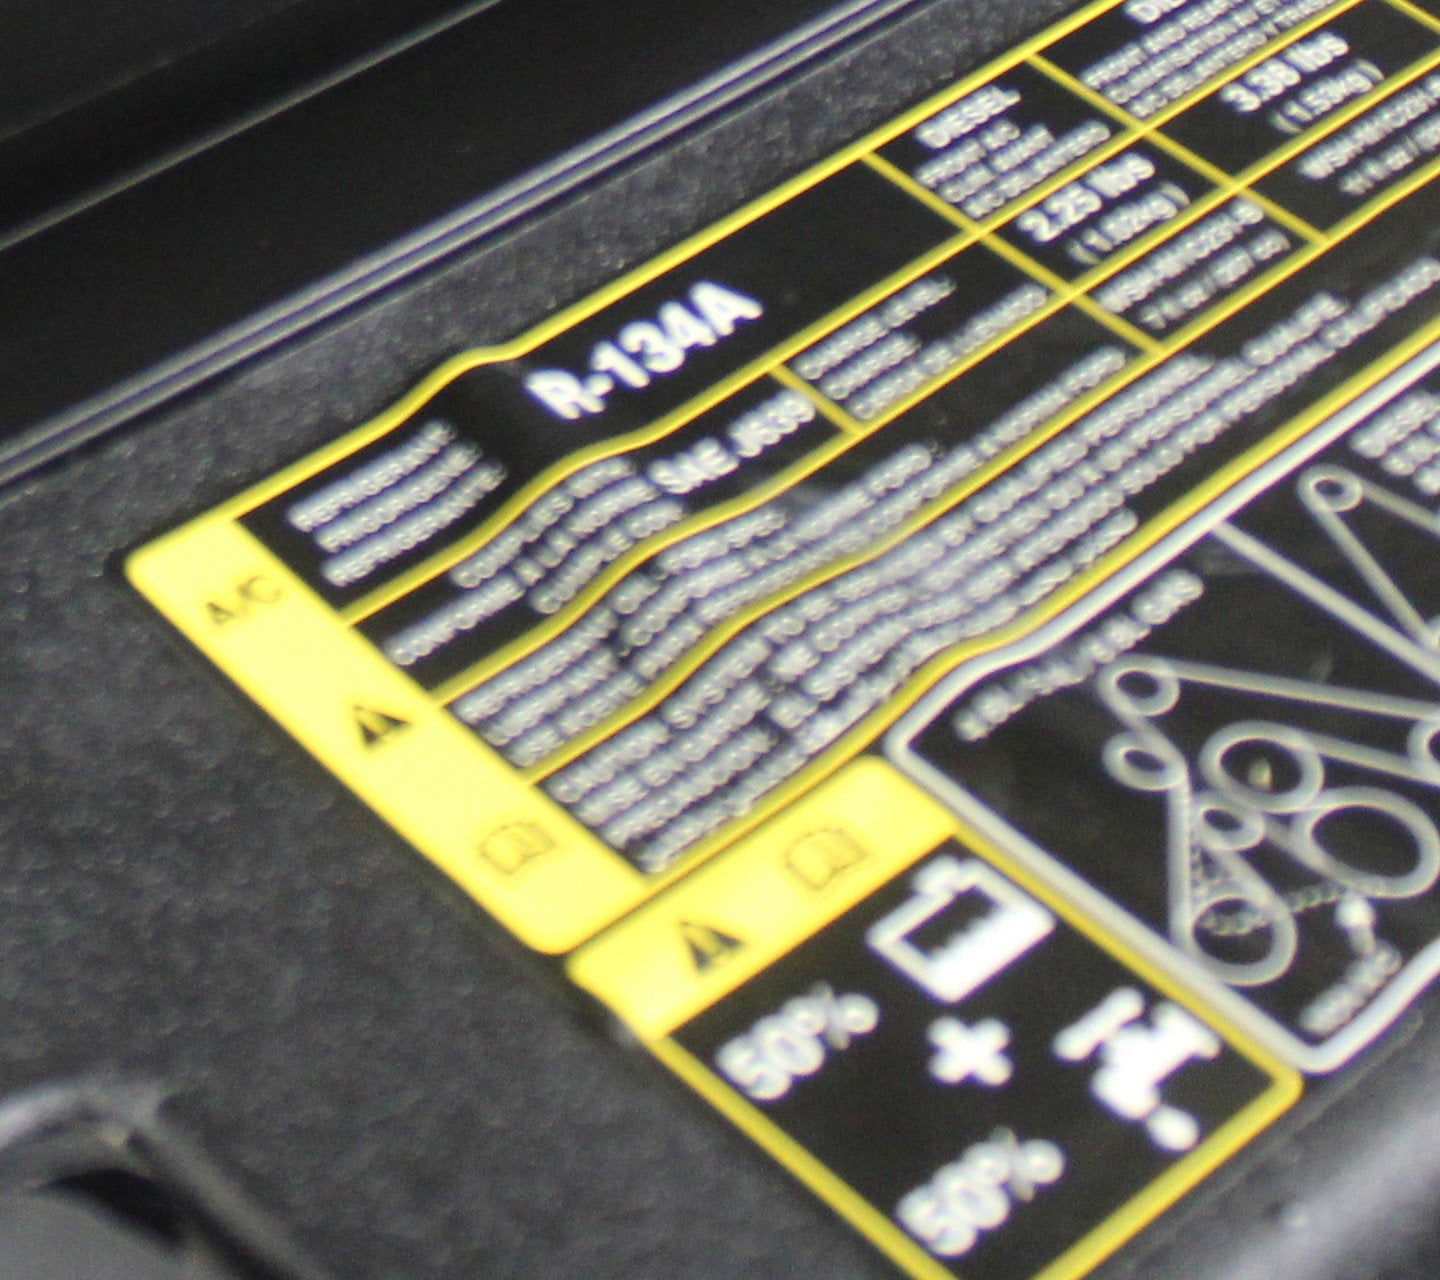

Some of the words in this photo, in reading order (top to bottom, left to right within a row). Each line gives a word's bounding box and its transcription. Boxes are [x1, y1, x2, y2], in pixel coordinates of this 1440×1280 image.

[1224, 59, 1299, 111] 3.38
[1284, 32, 1347, 72] lbs
[918, 87, 1018, 148] DIESEL
[1020, 184, 1100, 241] 2.25
[1086, 154, 1153, 197] lbs
[527, 282, 758, 417] R-134A
[648, 439, 738, 494] SAE
[199, 571, 283, 630] A/C
[715, 982, 880, 1102] 50%
[895, 1126, 1067, 1258] 50%
